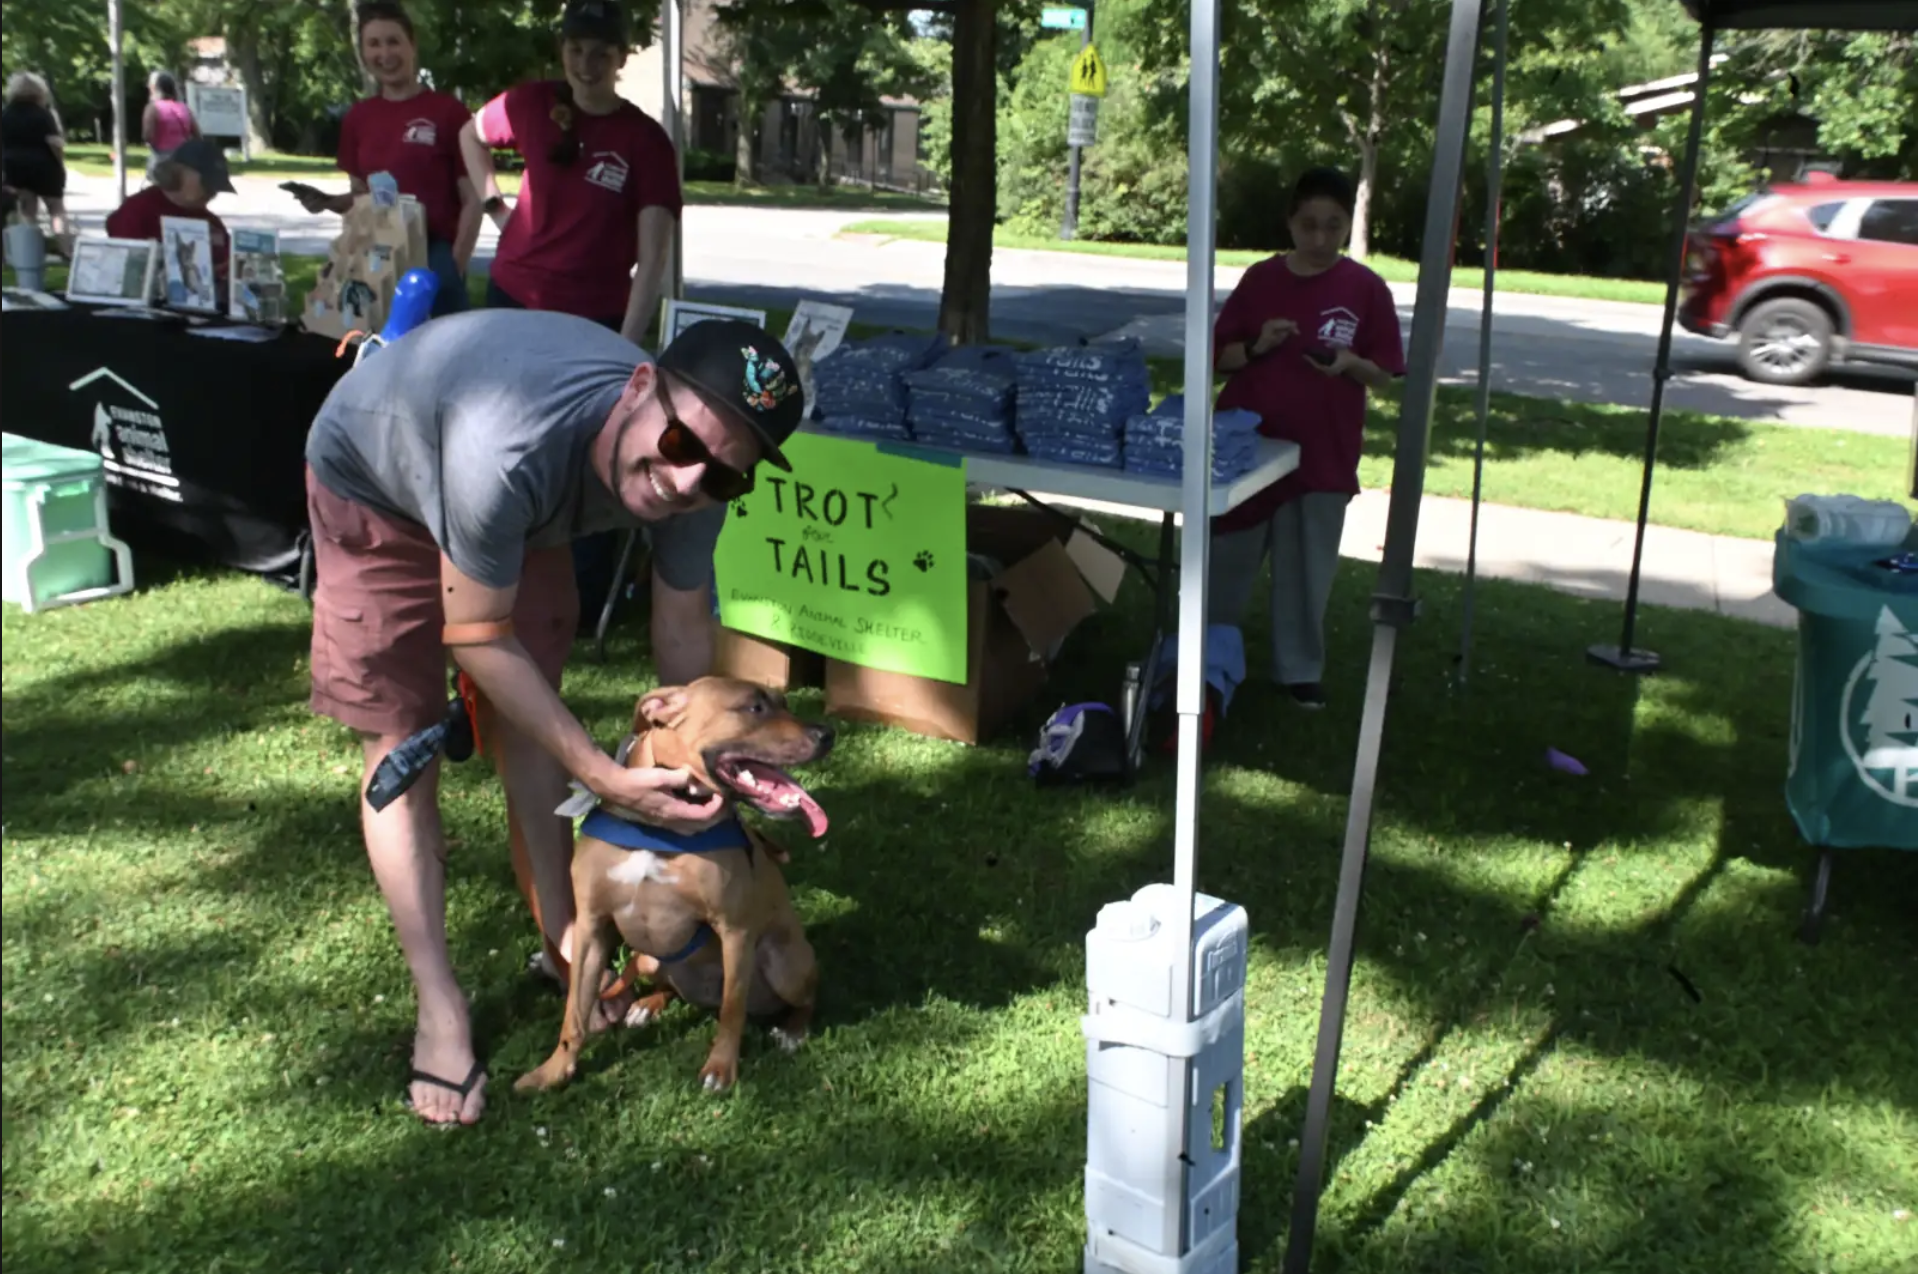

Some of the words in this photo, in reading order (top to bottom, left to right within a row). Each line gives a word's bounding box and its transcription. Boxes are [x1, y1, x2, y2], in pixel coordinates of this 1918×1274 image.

[765, 476, 879, 529] TROT
[765, 537, 891, 596] TAILS
[854, 616, 928, 645] SHELTER
